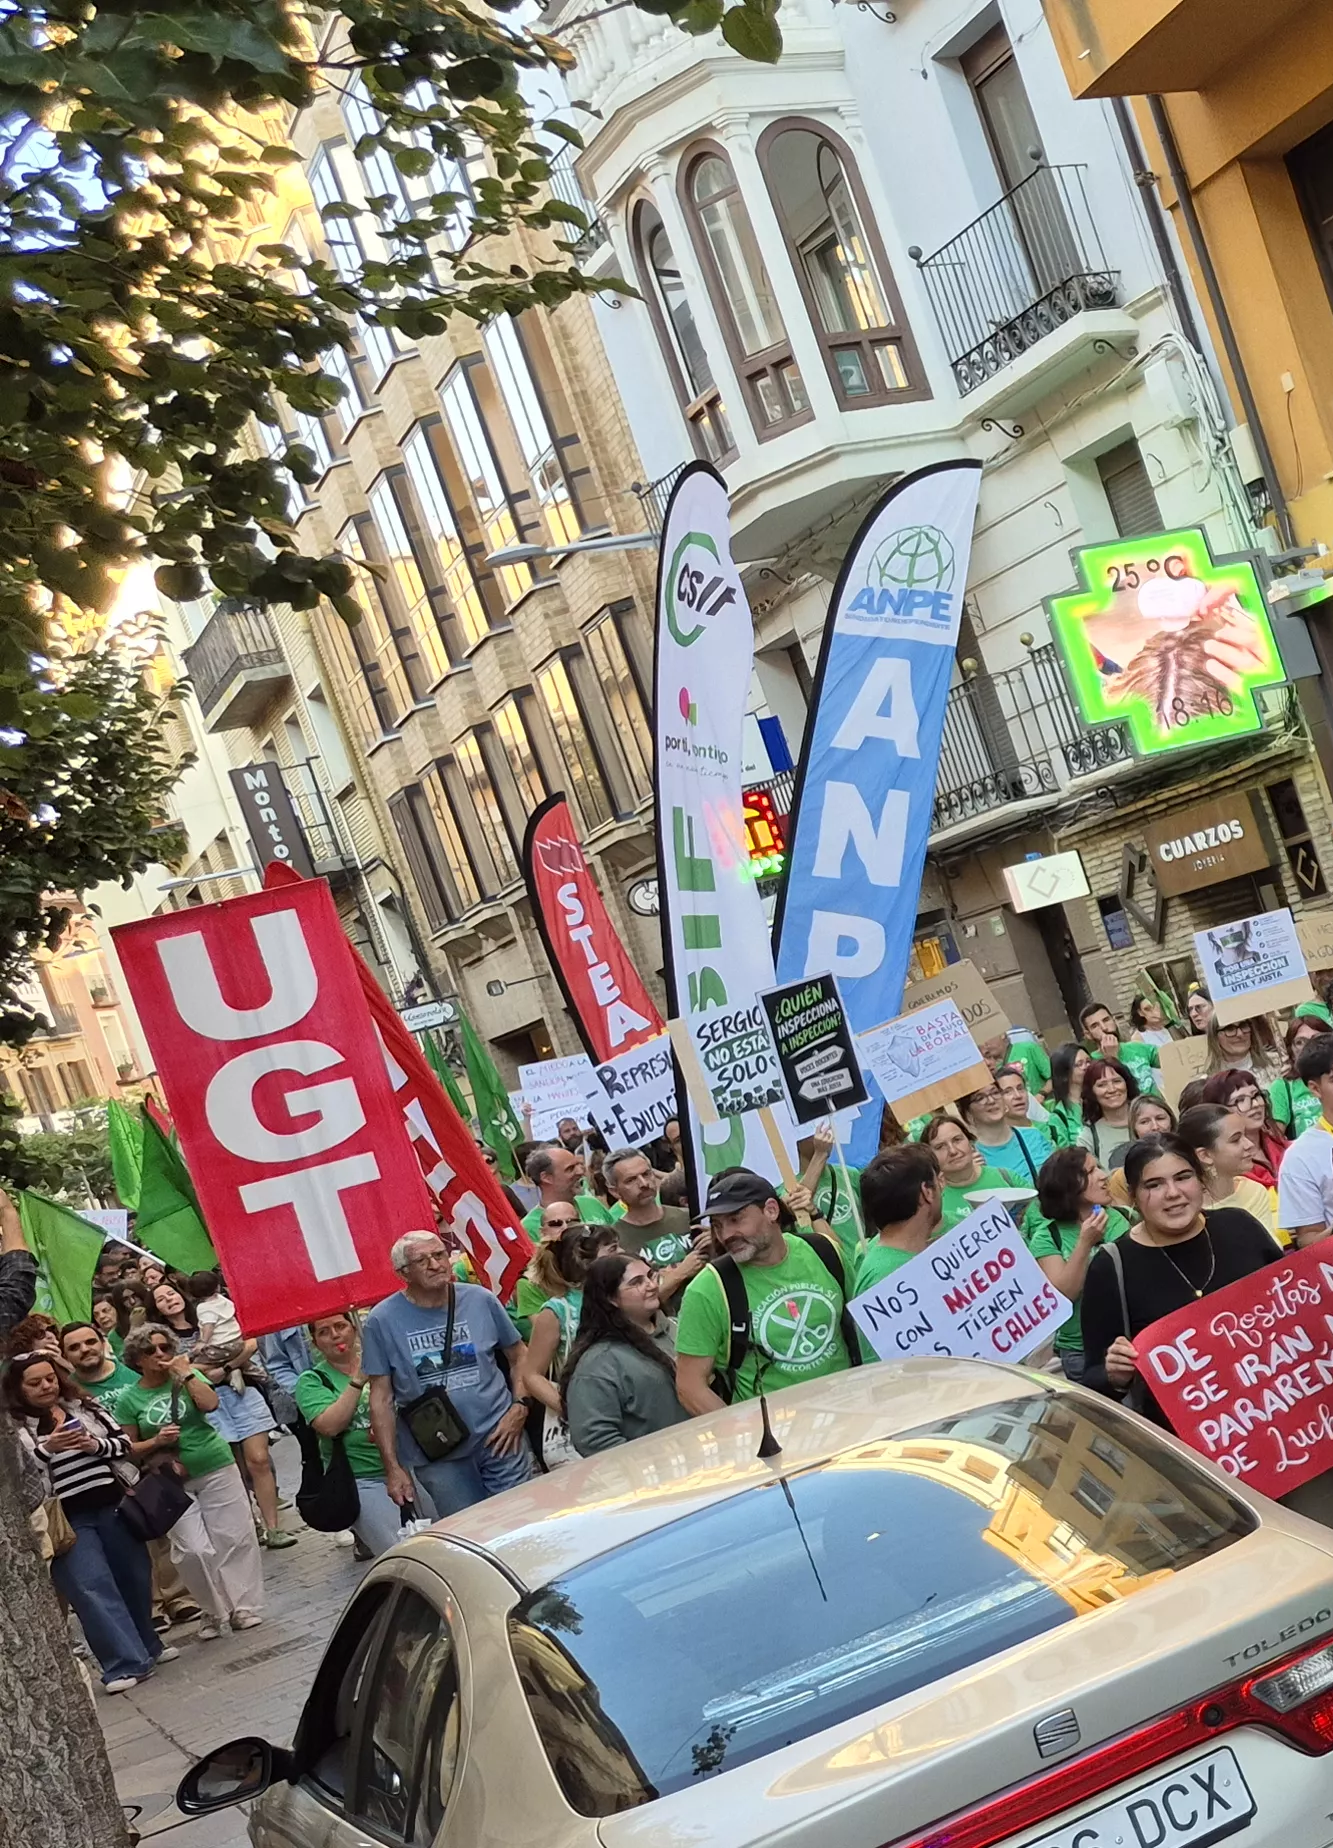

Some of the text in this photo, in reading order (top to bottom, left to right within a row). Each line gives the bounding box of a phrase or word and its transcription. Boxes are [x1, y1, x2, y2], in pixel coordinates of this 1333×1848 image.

[1107, 563, 1140, 593] 25
[847, 587, 954, 622] ANPE
[1159, 819, 1245, 864] CUARZOS
[556, 883, 654, 1048] STEA
[1257, 972, 1283, 986] JUSTA
[774, 981, 823, 1024] ¿QUIÉN
[777, 997, 840, 1040] INSPECCIONA
[916, 1010, 960, 1036] BASTA
[781, 1044, 789, 1056] A
[788, 1011, 842, 1050] INSPECCIÓN?
[909, 1029, 969, 1058] LABORAL
[921, 1018, 964, 1043] DE ABUSO
[707, 1046, 735, 1069] NO
[717, 1054, 768, 1092] SOLO
[156, 908, 381, 1283] UGT
[896, 1311, 934, 1351] CON
[991, 1282, 1060, 1353] CALLES
[1149, 1328, 1213, 1384] DE
[1210, 1268, 1322, 1350] Rositas
[1182, 1370, 1229, 1412] SE
[1217, 1442, 1258, 1478] DE
[1222, 1608, 1333, 1669] TOLEDO
[1126, 1764, 1232, 1848] DCX
